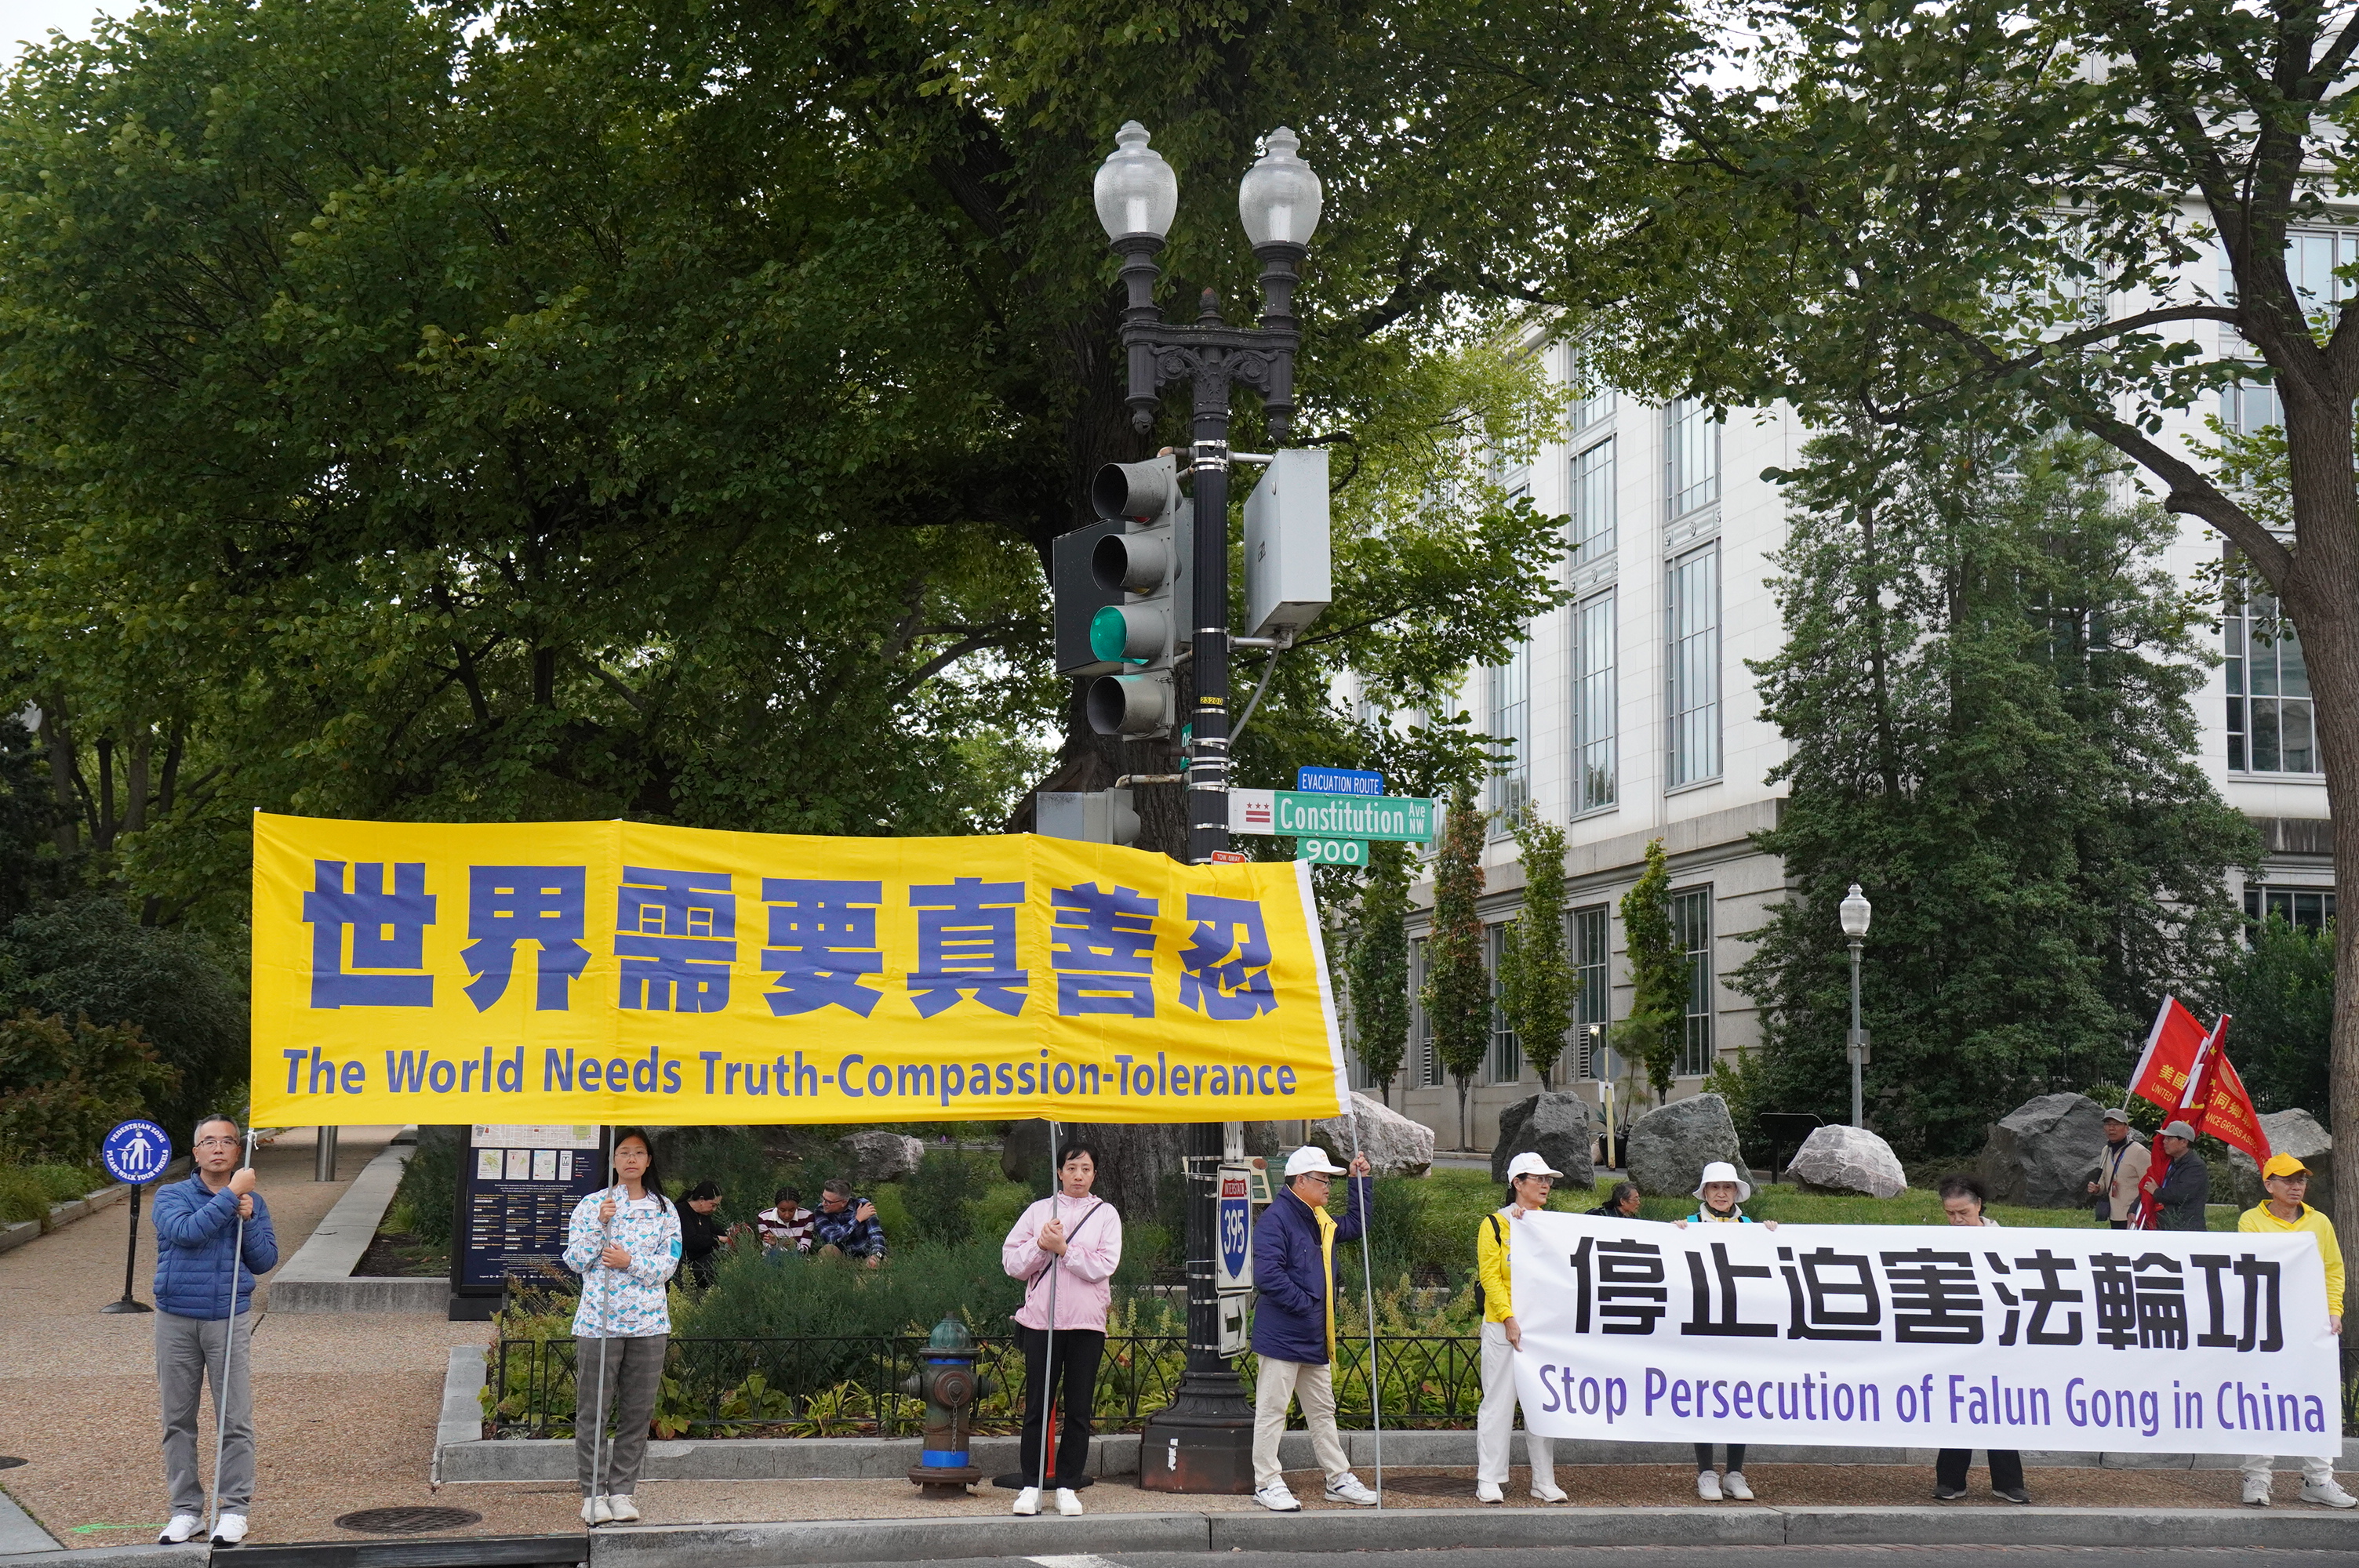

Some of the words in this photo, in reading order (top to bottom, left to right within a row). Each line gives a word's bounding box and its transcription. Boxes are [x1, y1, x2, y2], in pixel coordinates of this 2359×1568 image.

[1302, 773, 1353, 793] EVACUATION
[1354, 777, 1379, 795] ROUTE
[1280, 798, 1404, 834] Constitution
[1408, 801, 1426, 818] Ave
[1409, 818, 1424, 834] NW
[1307, 840, 1360, 862] 900
[303, 858, 1278, 1021] 世界需要真善忍
[283, 1047, 365, 1094] The
[385, 1045, 525, 1094] World
[543, 1045, 682, 1094] Needs
[700, 1049, 1297, 1107] Truth-Compassion-Tolerance
[2151, 1082, 2173, 1102] UNITED
[2220, 1120, 2244, 1138] GROSS
[110, 1123, 152, 1143] PEDESTRIAN
[150, 1127, 166, 1144] ZONE
[106, 1149, 120, 1173] PLEASE
[118, 1170, 136, 1181] WALK
[136, 1171, 156, 1181] YOUR
[153, 1149, 169, 1173] WHEELS
[1224, 1182, 1245, 1195] INTERSTATE
[1223, 1209, 1244, 1254] 395
[1570, 1236, 2284, 1352] 停止迫害法輪功
[1539, 1364, 1627, 1424] Stop
[1645, 1367, 1880, 1422] Persecution
[1896, 1373, 1933, 1424] of
[1948, 1374, 2050, 1426] Falun
[2066, 1377, 2158, 1437] Gong
[2174, 1380, 2203, 1429] in
[2217, 1381, 2326, 1433] China
